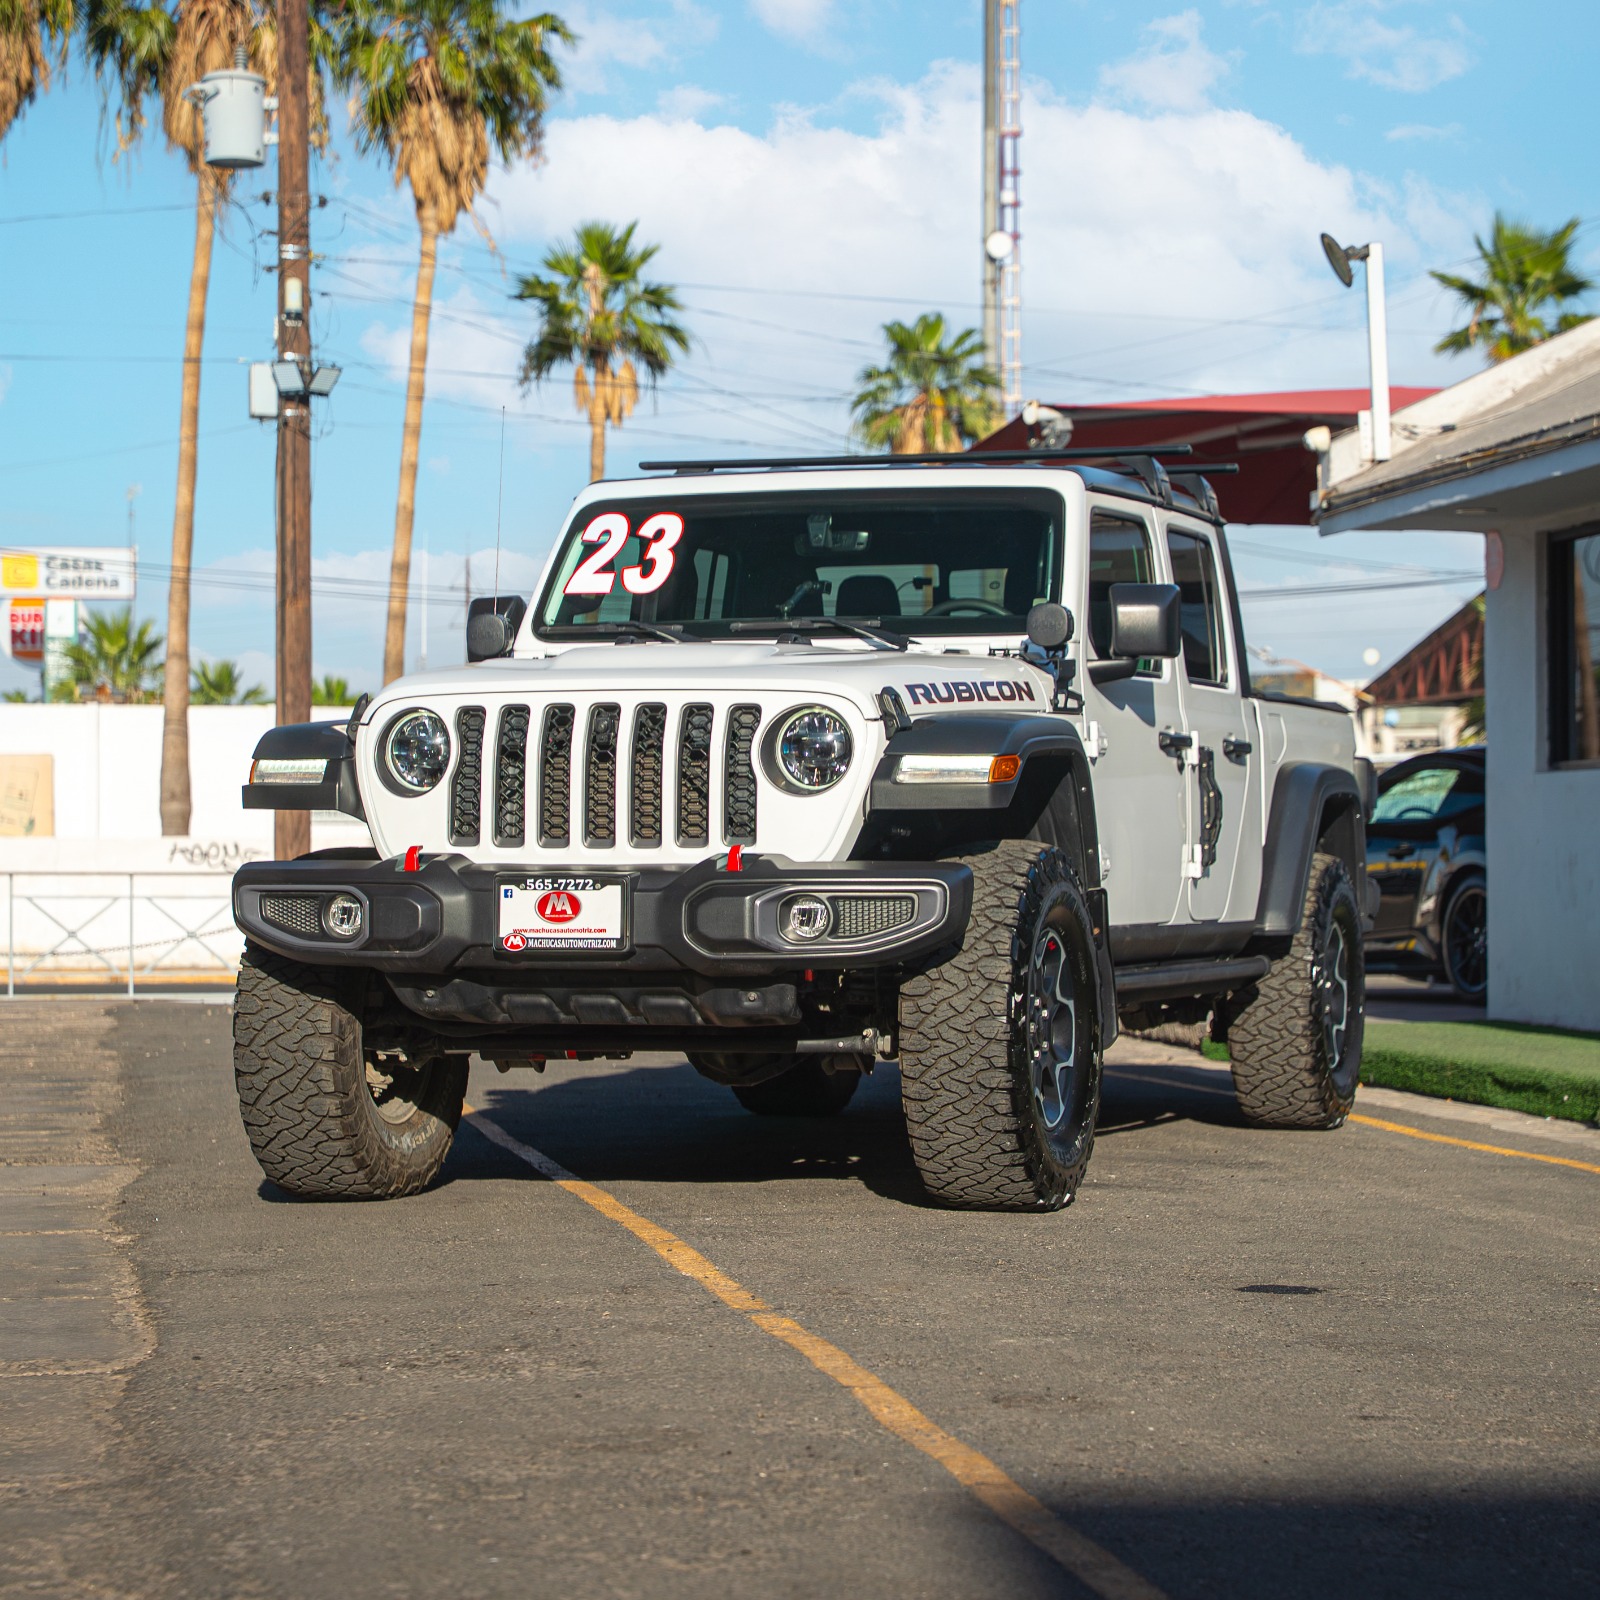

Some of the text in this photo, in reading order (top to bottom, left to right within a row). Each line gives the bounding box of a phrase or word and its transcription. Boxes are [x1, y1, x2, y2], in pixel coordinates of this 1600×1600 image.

[563, 511, 685, 594] 23
[11, 629, 44, 644] KI
[904, 681, 1036, 705] RUBICON
[526, 878, 594, 890] 565-7272
[527, 938, 617, 948] MACHUCASAUTOMOTRIZ.COM
